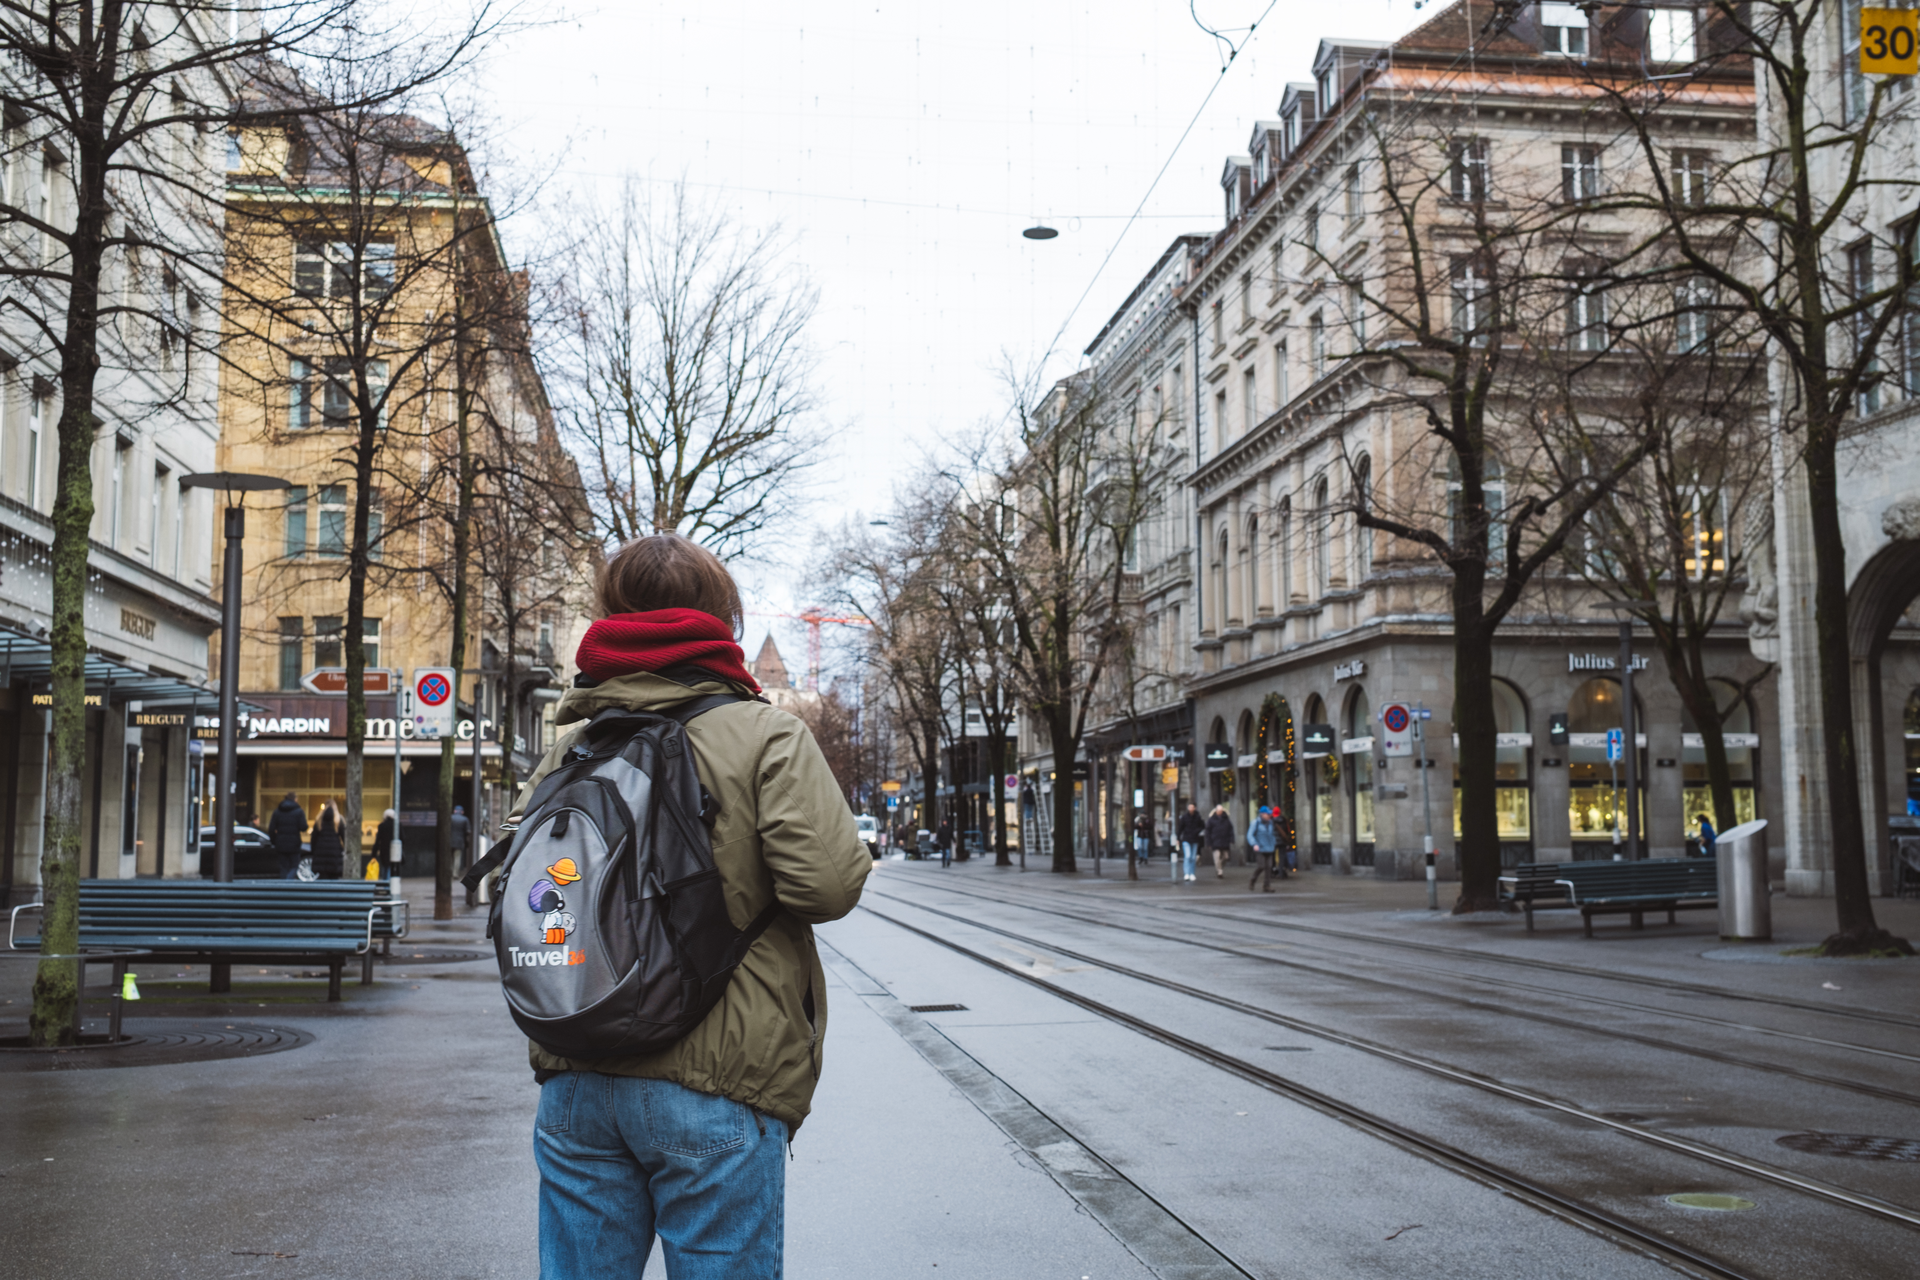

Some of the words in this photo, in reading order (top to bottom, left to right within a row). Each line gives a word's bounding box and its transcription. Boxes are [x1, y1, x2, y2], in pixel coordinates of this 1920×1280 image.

[1866, 25, 1914, 60] 30
[120, 608, 156, 641] BREGUET
[1568, 653, 1615, 672] Julius
[136, 715, 186, 725] BREGUET
[250, 718, 330, 733] NARDIN
[364, 718, 492, 740] meer
